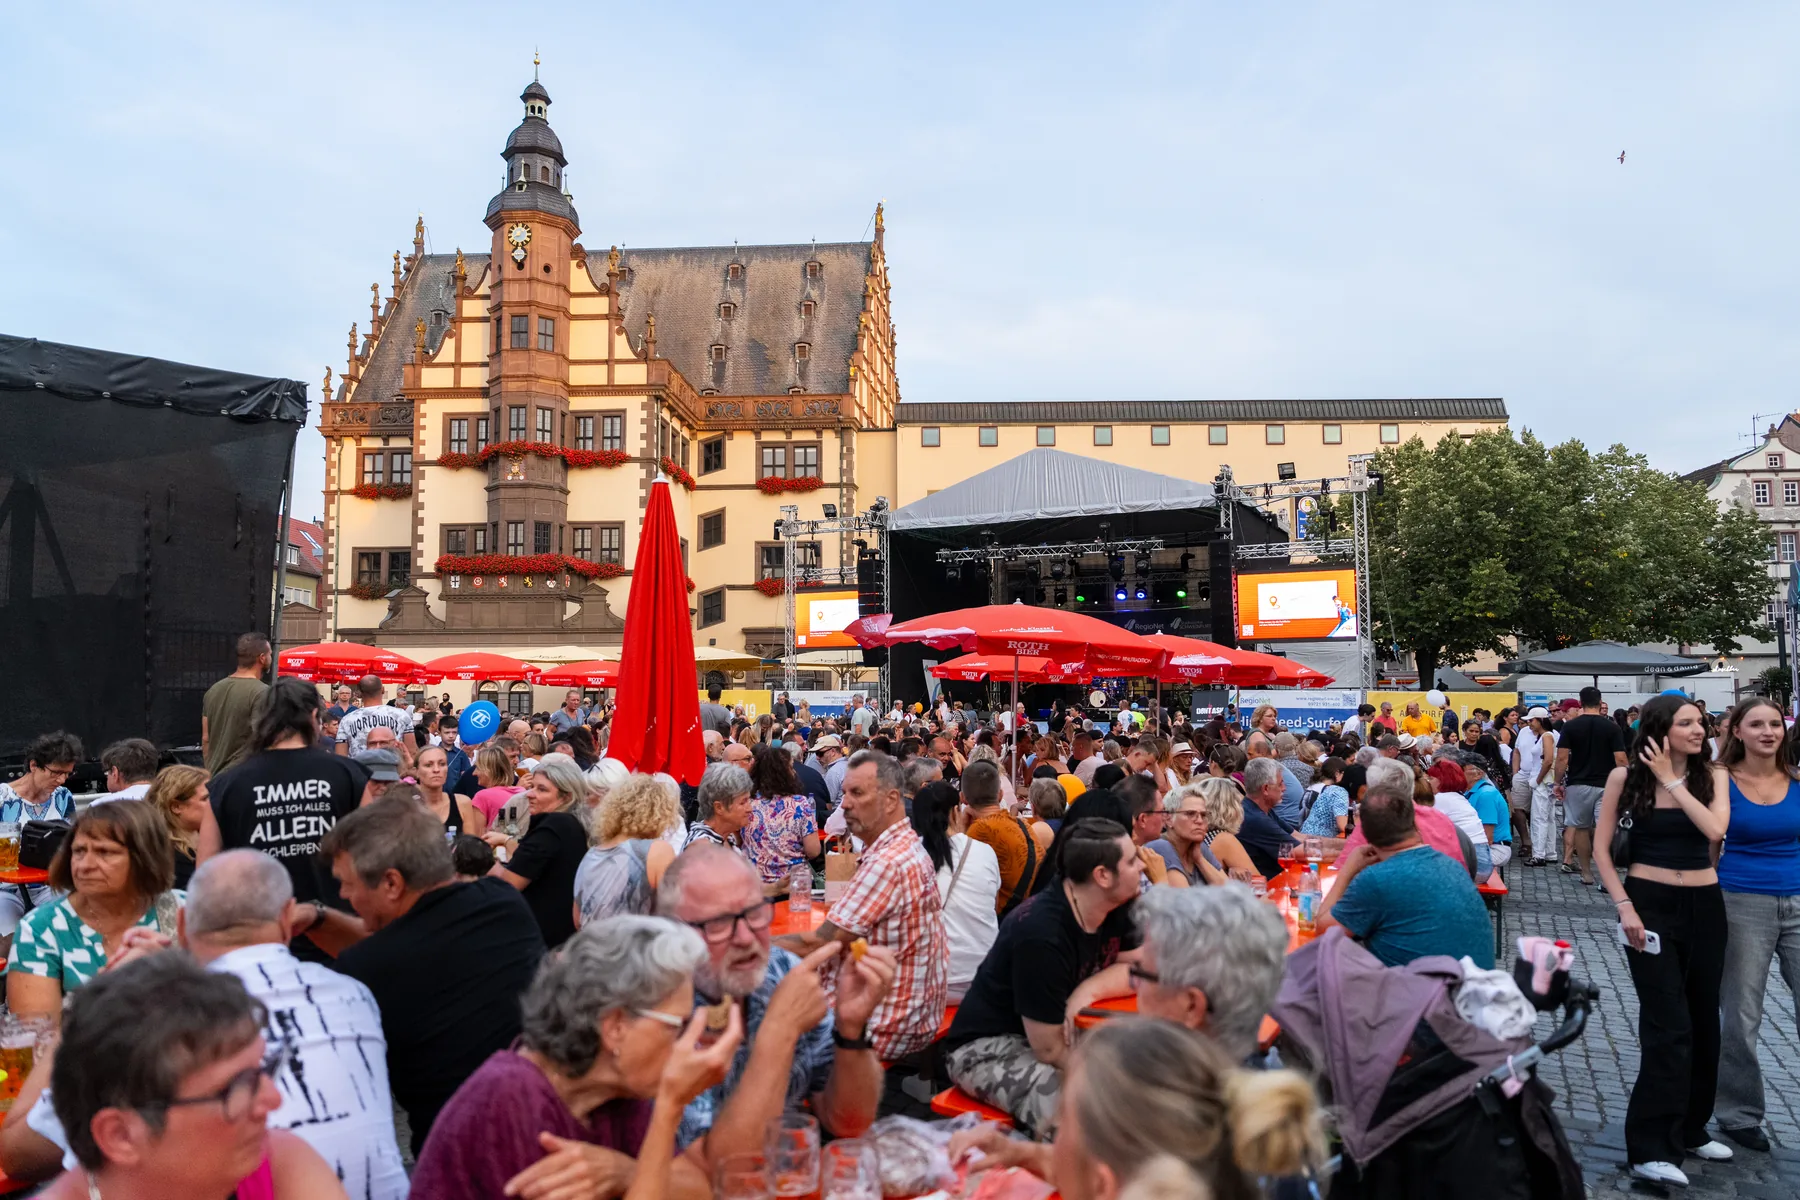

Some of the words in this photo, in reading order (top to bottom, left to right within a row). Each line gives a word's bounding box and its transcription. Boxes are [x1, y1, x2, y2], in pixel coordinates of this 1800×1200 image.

[1134, 623, 1164, 632] RegioNet
[1007, 640, 1050, 650] ROTH
[1016, 648, 1040, 656] BIER
[961, 670, 978, 678] ROTH
[1240, 697, 1271, 705] RegioNet
[253, 779, 331, 805] IMMER
[256, 805, 284, 818] MUSS
[285, 803, 302, 814] ICH
[304, 801, 331, 812] ALLES
[249, 815, 336, 844] ALLEIN
